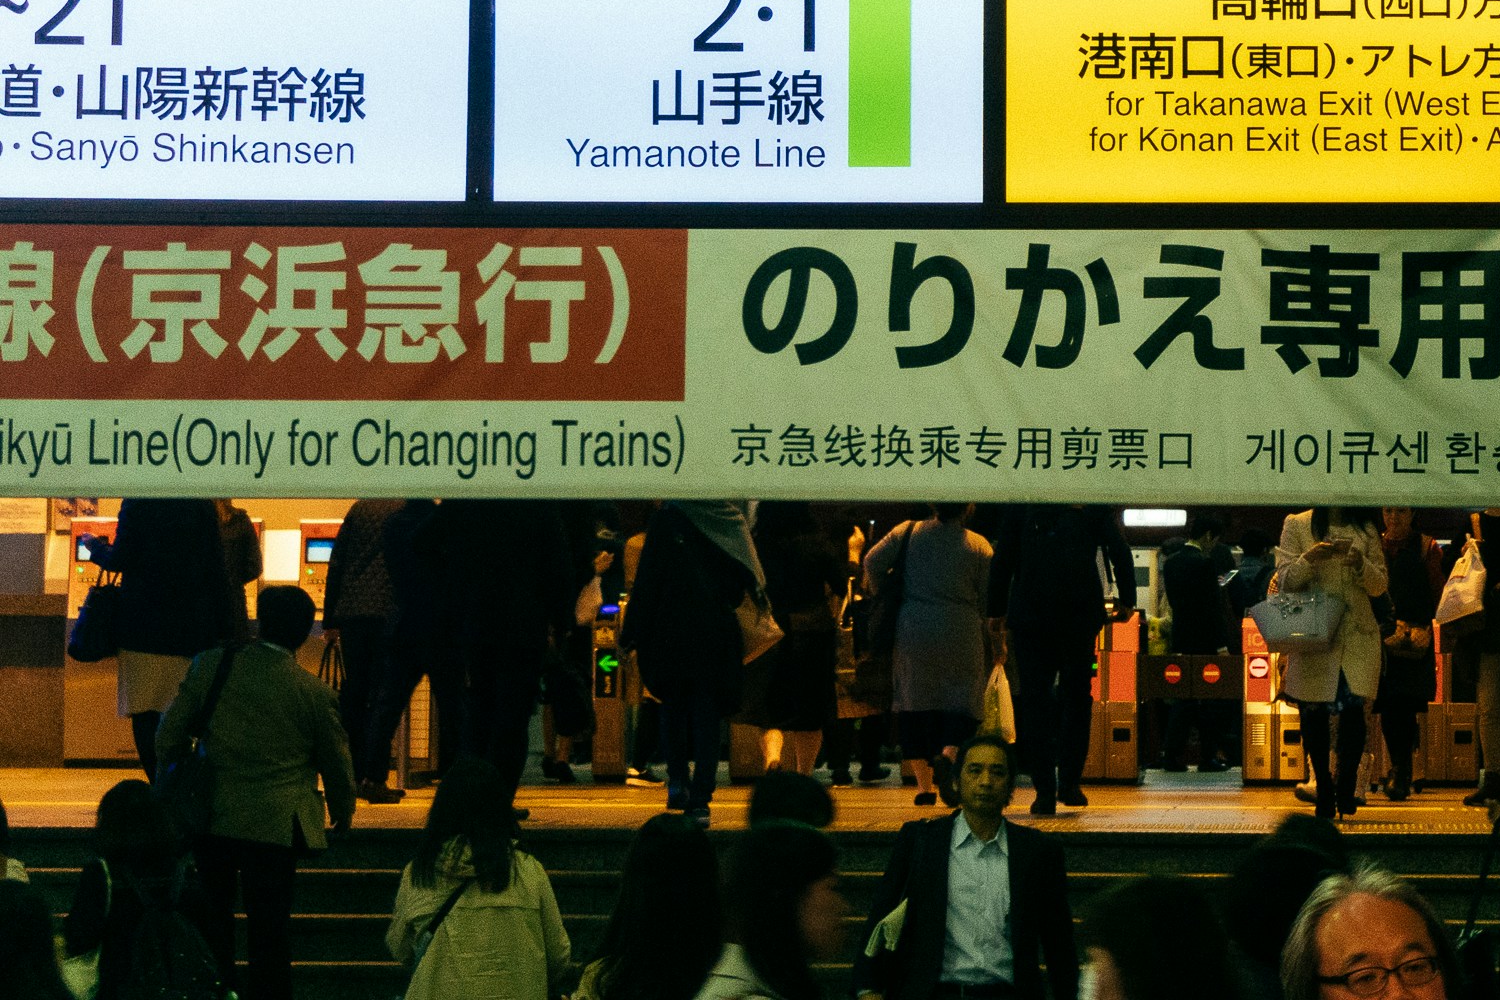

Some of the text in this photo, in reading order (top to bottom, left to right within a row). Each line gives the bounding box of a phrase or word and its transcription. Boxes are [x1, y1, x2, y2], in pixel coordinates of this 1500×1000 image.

[652, 69, 825, 126] 山手線
[1106, 90, 1145, 117] for
[1154, 90, 1307, 117] Takanawa
[1319, 90, 1372, 116] Exit
[1384, 88, 1470, 119] (West
[152, 132, 355, 165] Shinkansen
[566, 138, 826, 168] Yamanote Line
[1089, 126, 1128, 153] for
[1139, 126, 1234, 153] Kōnan
[1246, 126, 1300, 152] Exit
[1311, 124, 1388, 154] (East
[287, 418, 339, 467] for
[351, 418, 537, 481] Changing
[551, 415, 685, 475] Trains)
[730, 423, 1193, 471] 京急线换乘专用剪票口
[1245, 429, 1429, 475] 게이큐센
